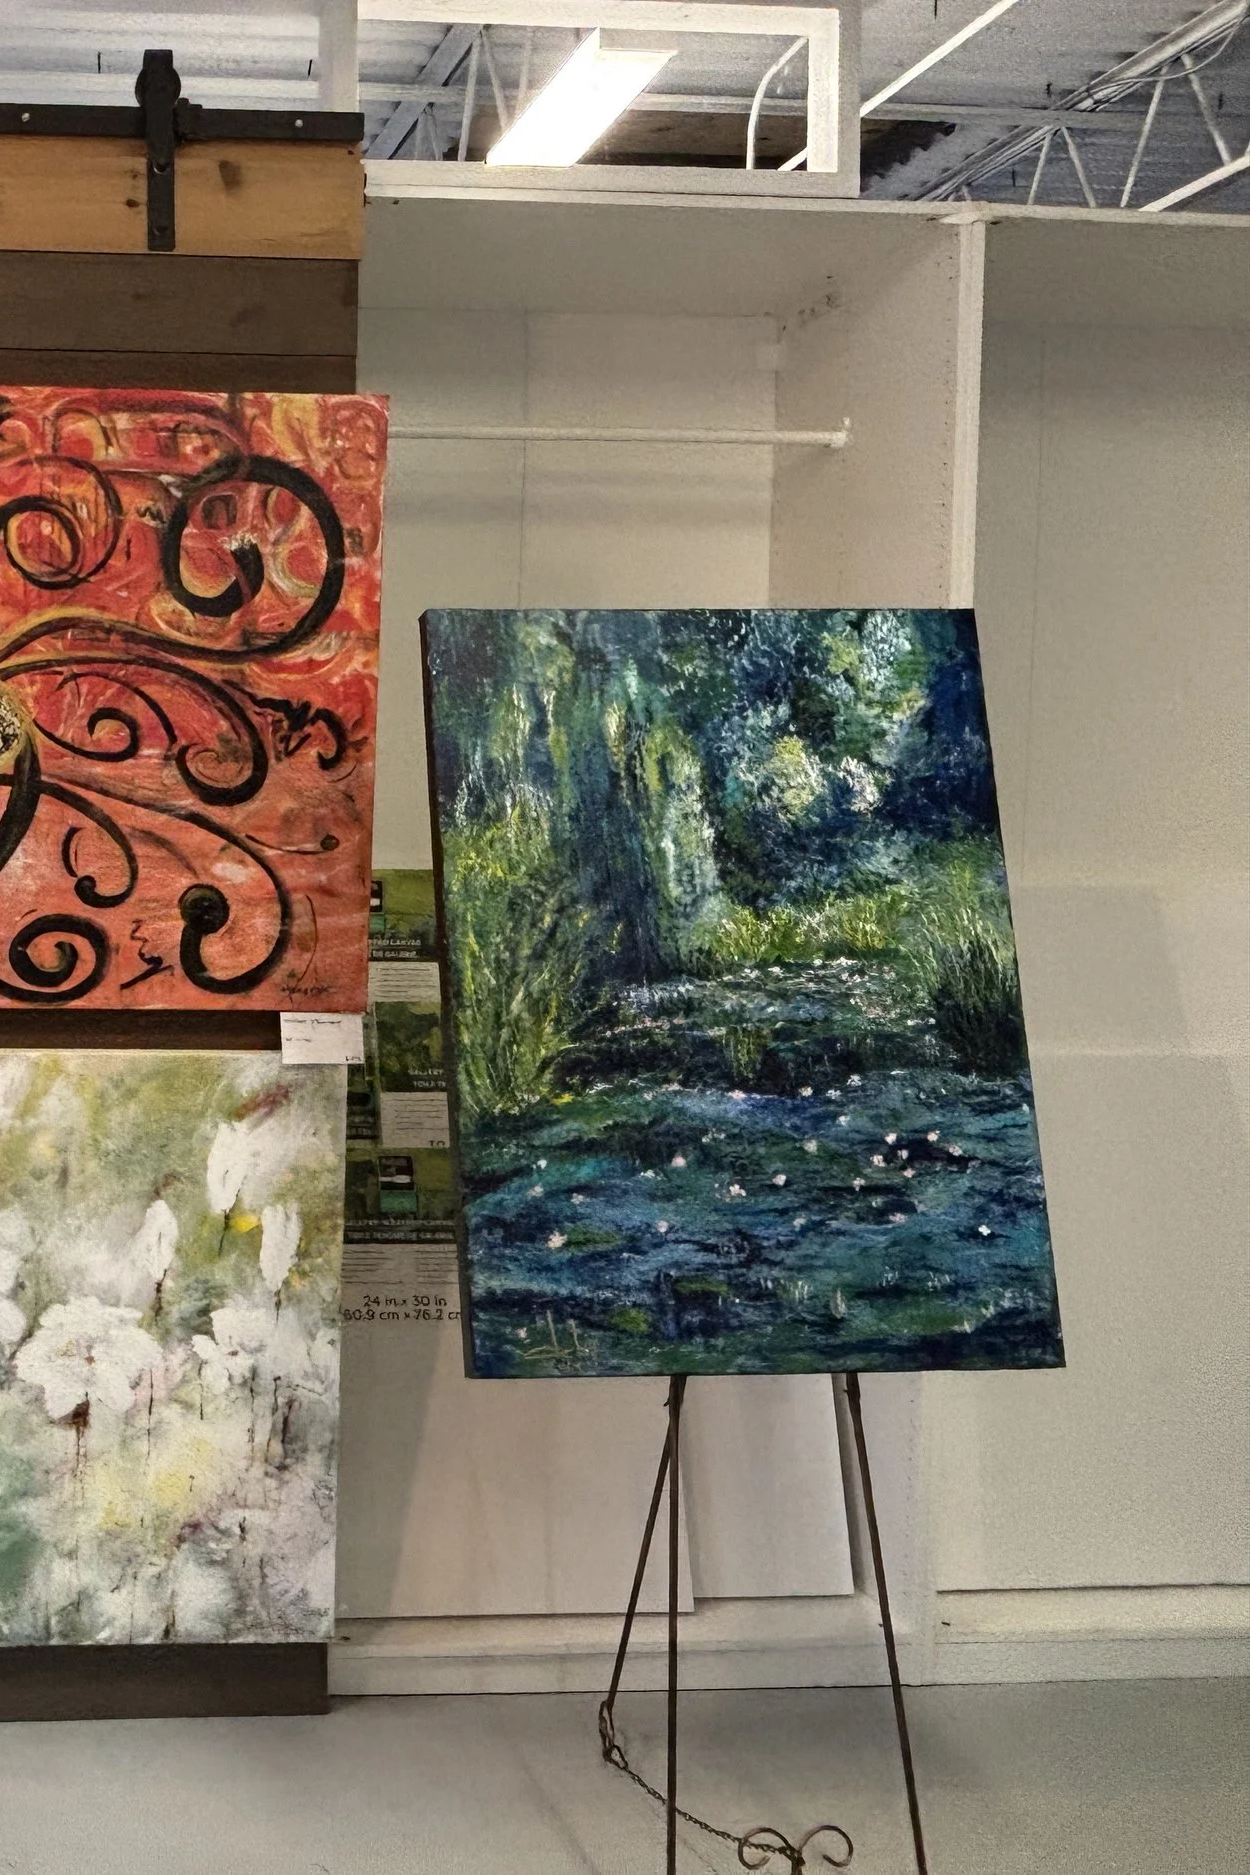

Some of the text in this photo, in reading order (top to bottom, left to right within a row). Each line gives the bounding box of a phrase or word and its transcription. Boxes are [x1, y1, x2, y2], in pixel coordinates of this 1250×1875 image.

[363, 1295, 381, 1307] 24
[412, 1295, 431, 1307] 30
[434, 1295, 448, 1307] in
[379, 1311, 400, 1320] cm
[412, 1308, 444, 1321] 76.2
